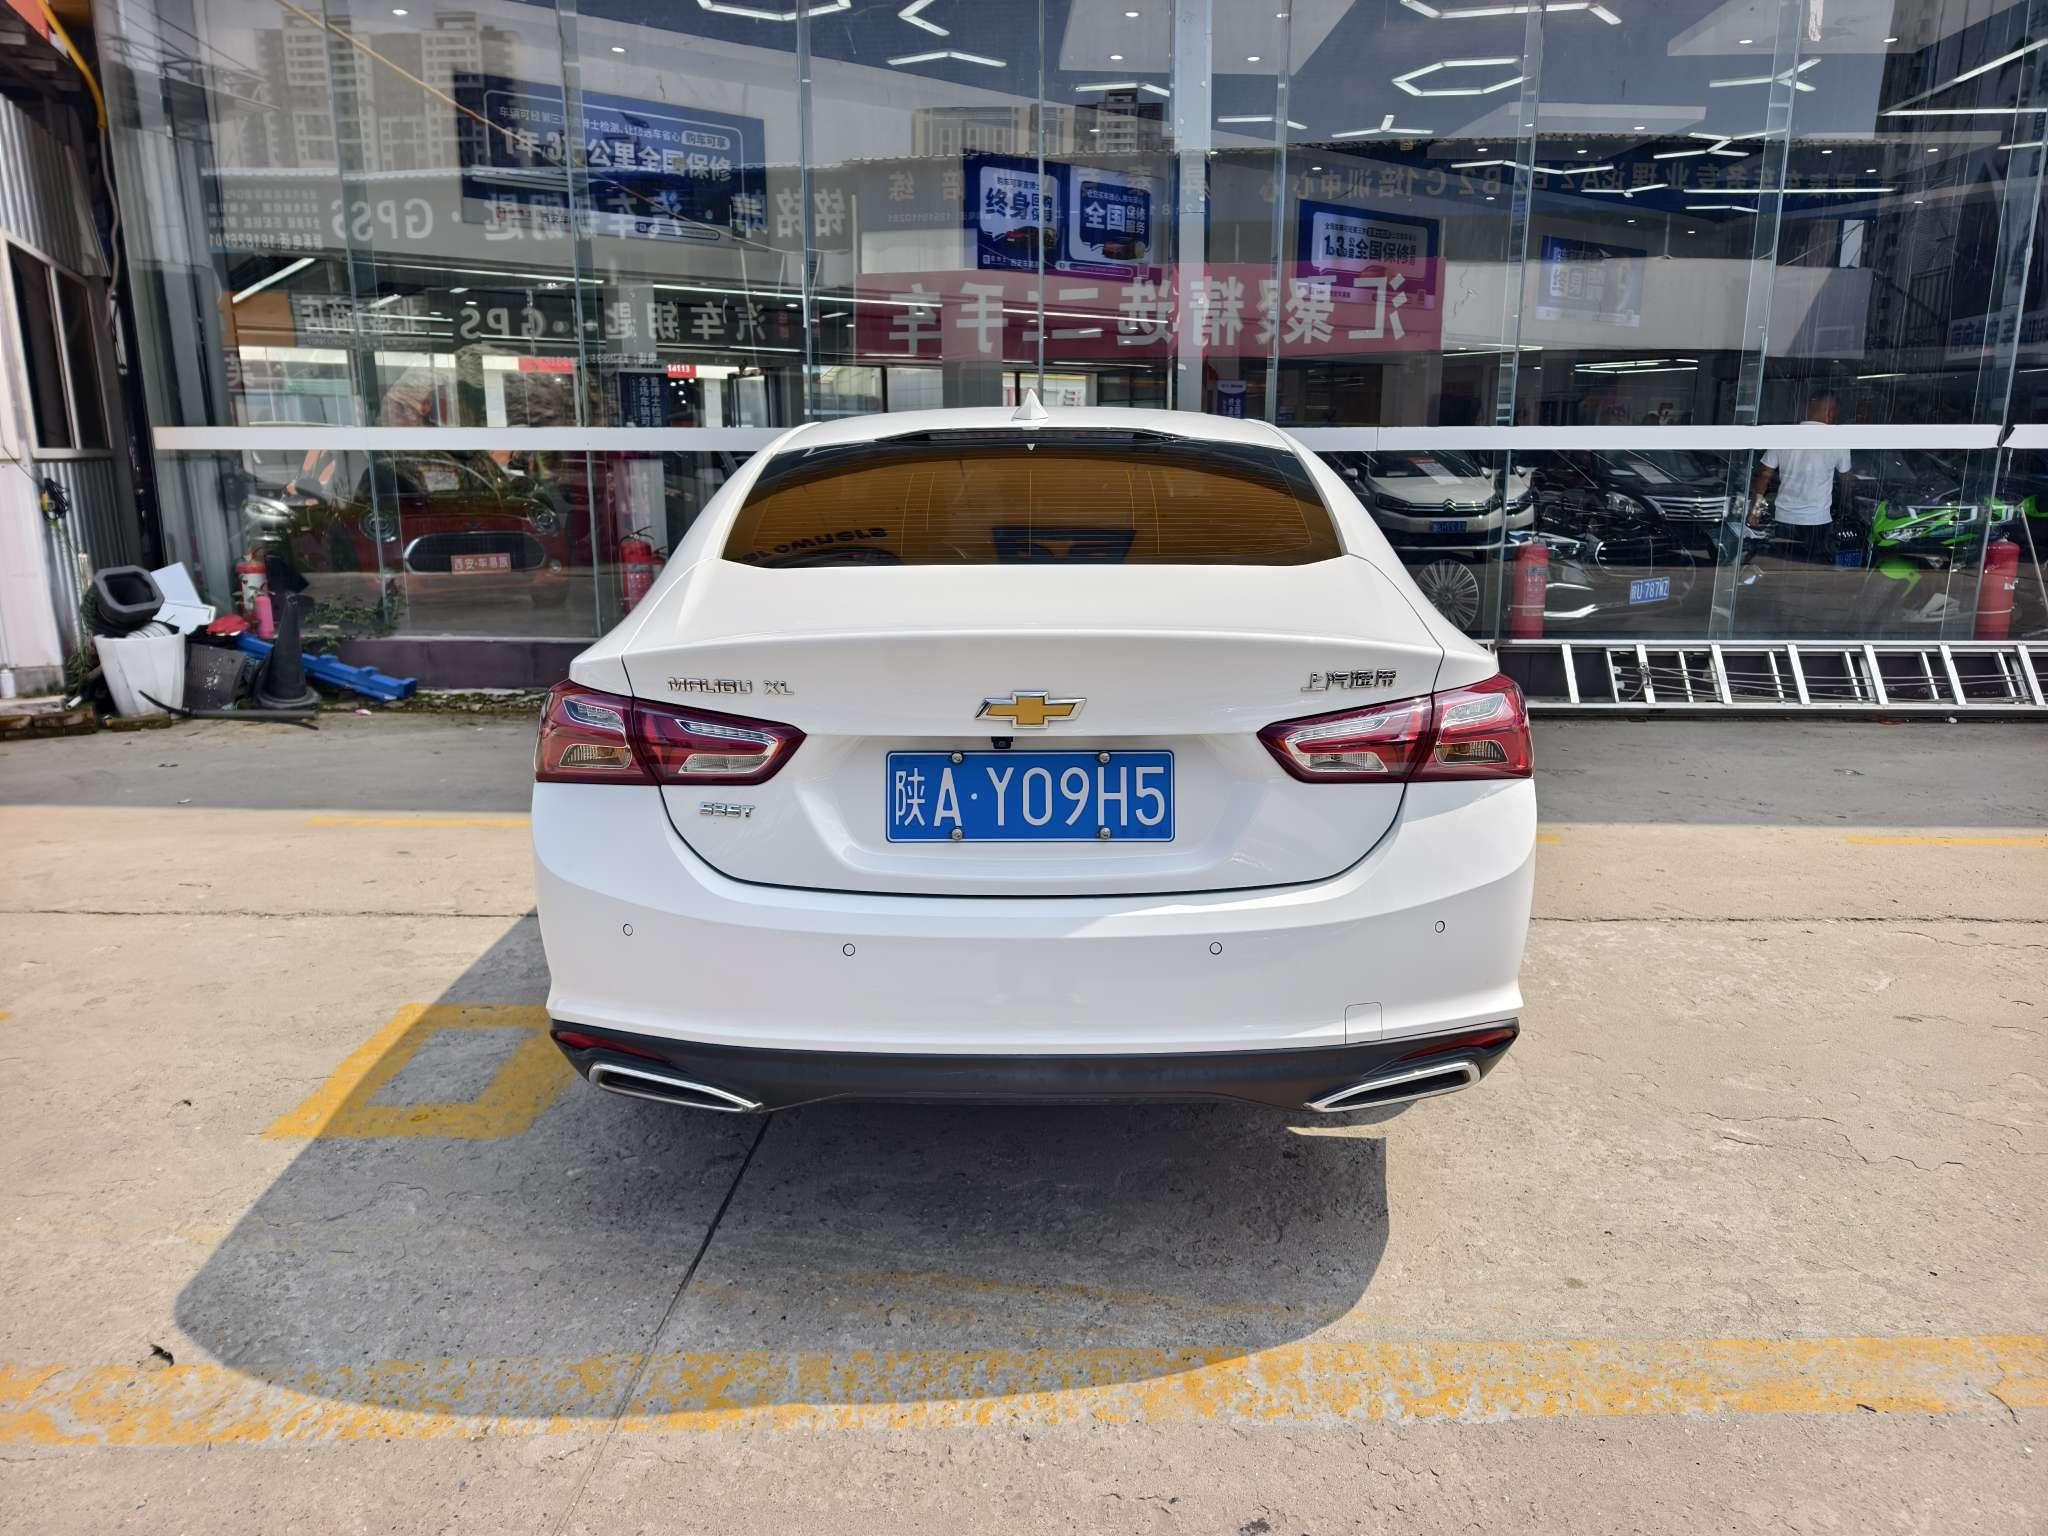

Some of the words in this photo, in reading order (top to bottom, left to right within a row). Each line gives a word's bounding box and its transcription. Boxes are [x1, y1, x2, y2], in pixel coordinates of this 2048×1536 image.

[985, 187, 1029, 220] 终身
[1084, 201, 1126, 232] 全国
[667, 676, 753, 694] MALIBU
[763, 679, 795, 696] XL
